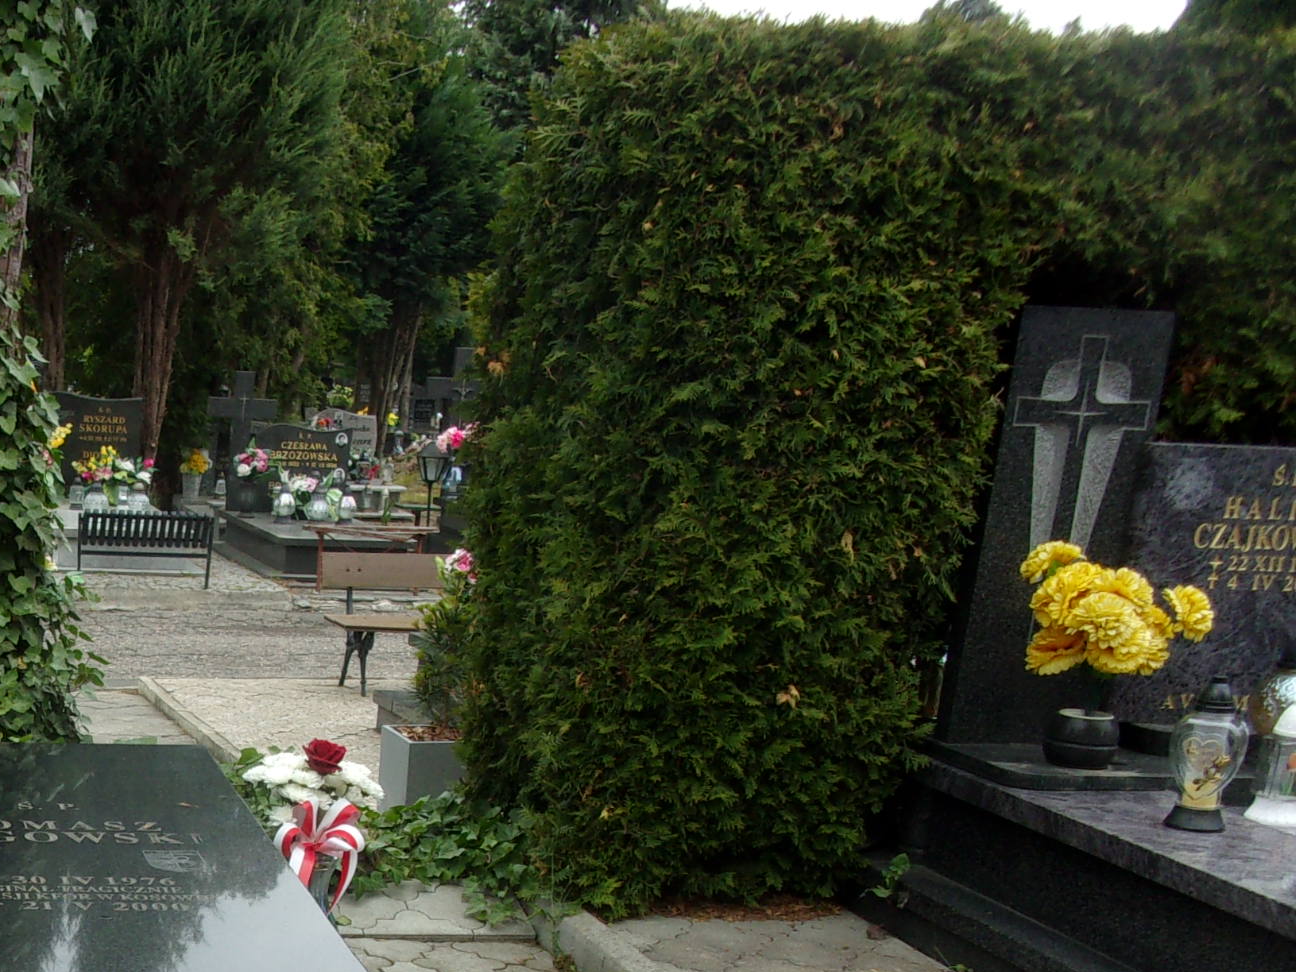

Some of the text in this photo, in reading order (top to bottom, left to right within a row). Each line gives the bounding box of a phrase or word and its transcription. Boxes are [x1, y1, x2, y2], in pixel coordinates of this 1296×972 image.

[105, 876, 176, 886] 1976
[23, 901, 52, 911] 21
[112, 901, 189, 912] 2000
